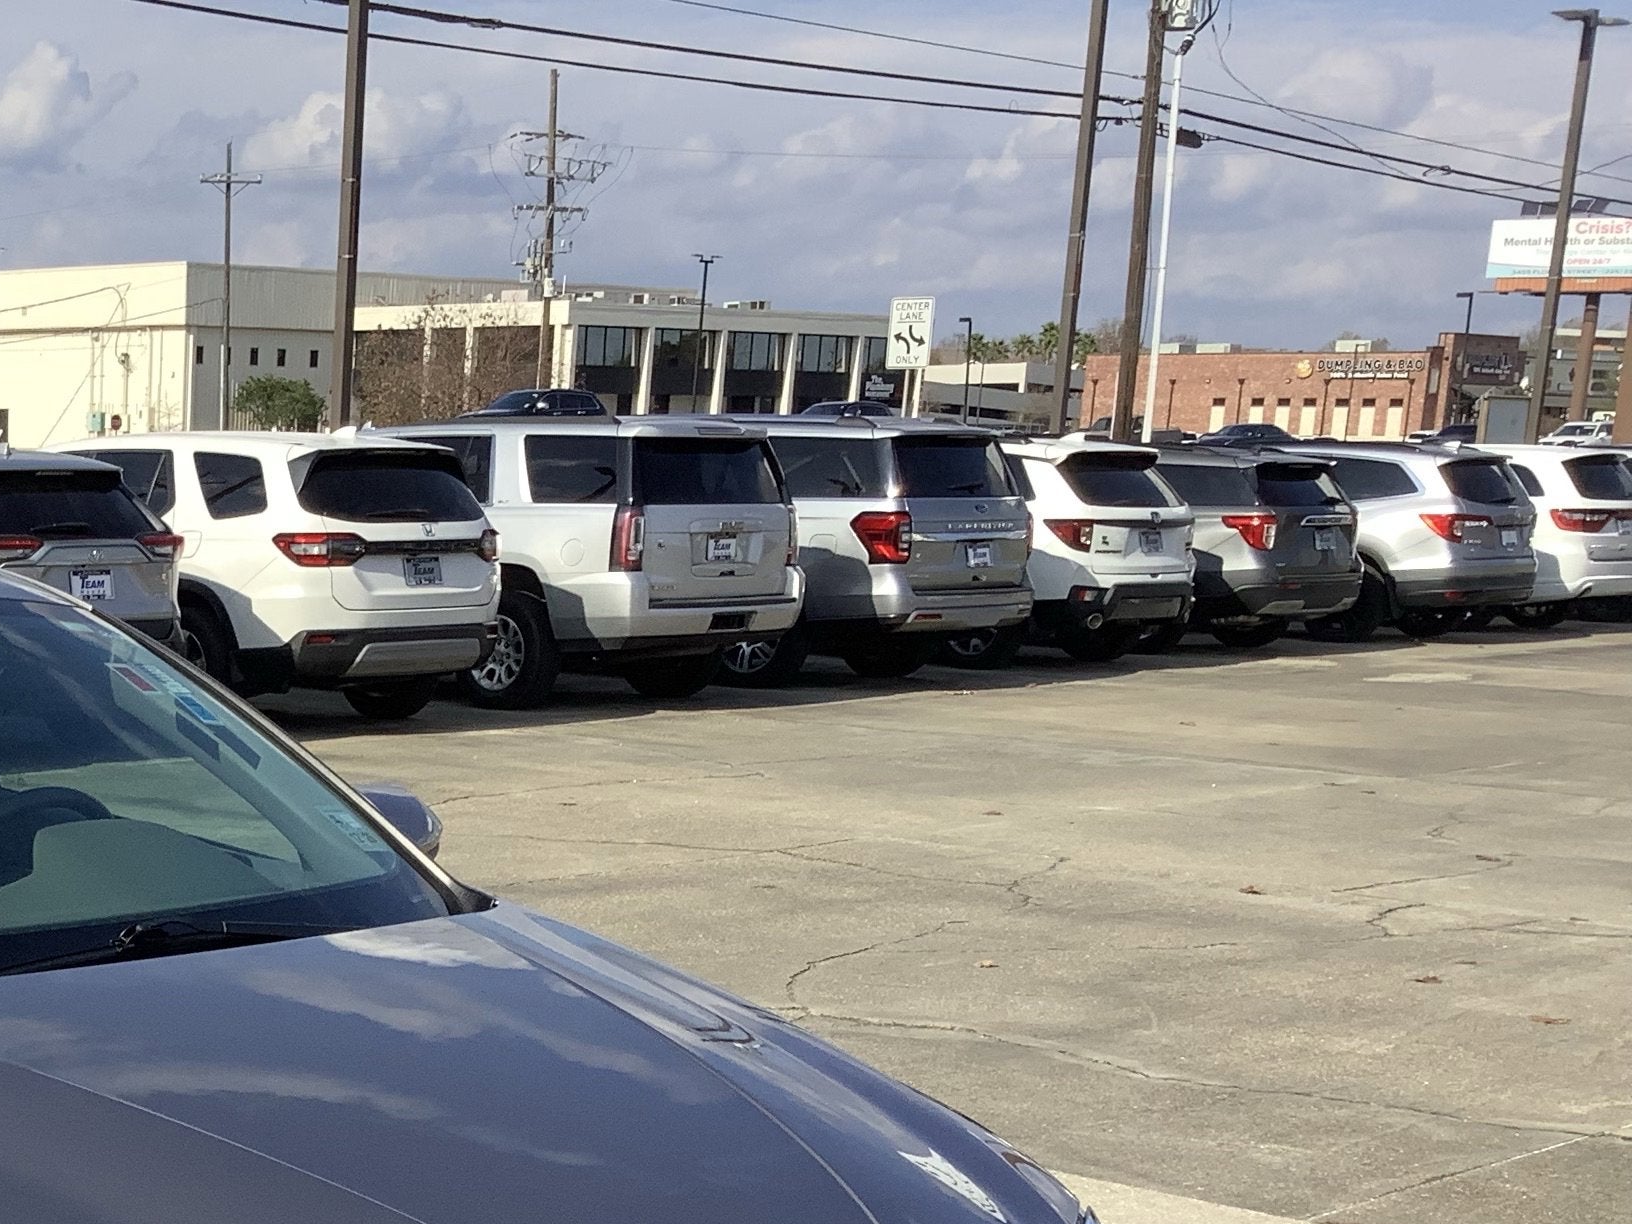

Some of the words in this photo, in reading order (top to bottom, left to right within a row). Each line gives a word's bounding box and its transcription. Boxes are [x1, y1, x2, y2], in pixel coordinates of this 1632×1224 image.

[1503, 237, 1542, 247] Mental
[895, 301, 930, 311] CENTER
[899, 311, 924, 320] LANE
[895, 355, 920, 364] ONLY
[1317, 359, 1382, 371] DUMPLING
[1385, 359, 1396, 370] &
[1397, 359, 1424, 370] BAO
[80, 573, 105, 589] TEAM
